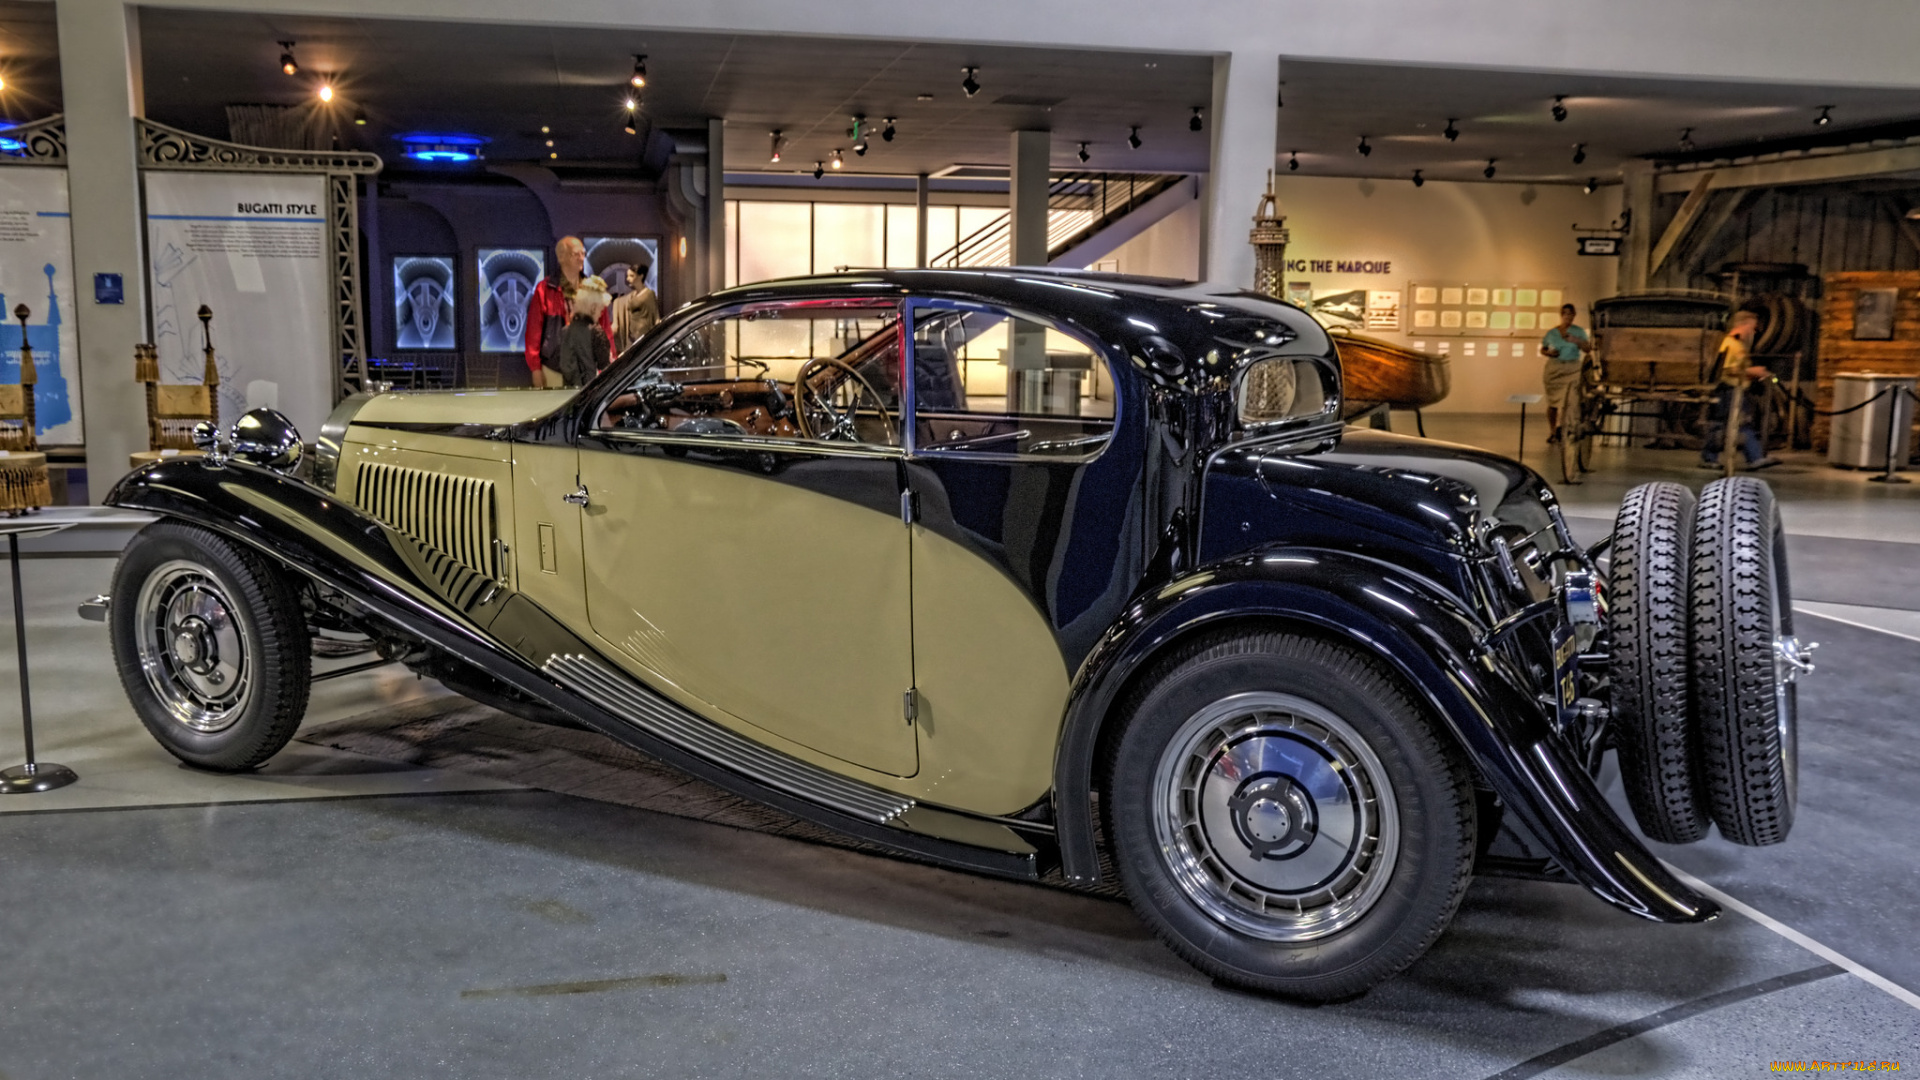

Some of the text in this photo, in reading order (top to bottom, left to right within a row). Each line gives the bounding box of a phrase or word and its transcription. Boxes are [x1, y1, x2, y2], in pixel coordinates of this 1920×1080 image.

[237, 202, 317, 215] BUGATTI STYLE
[1310, 260, 1333, 273] THE
[1336, 261, 1391, 274] MARQUE
